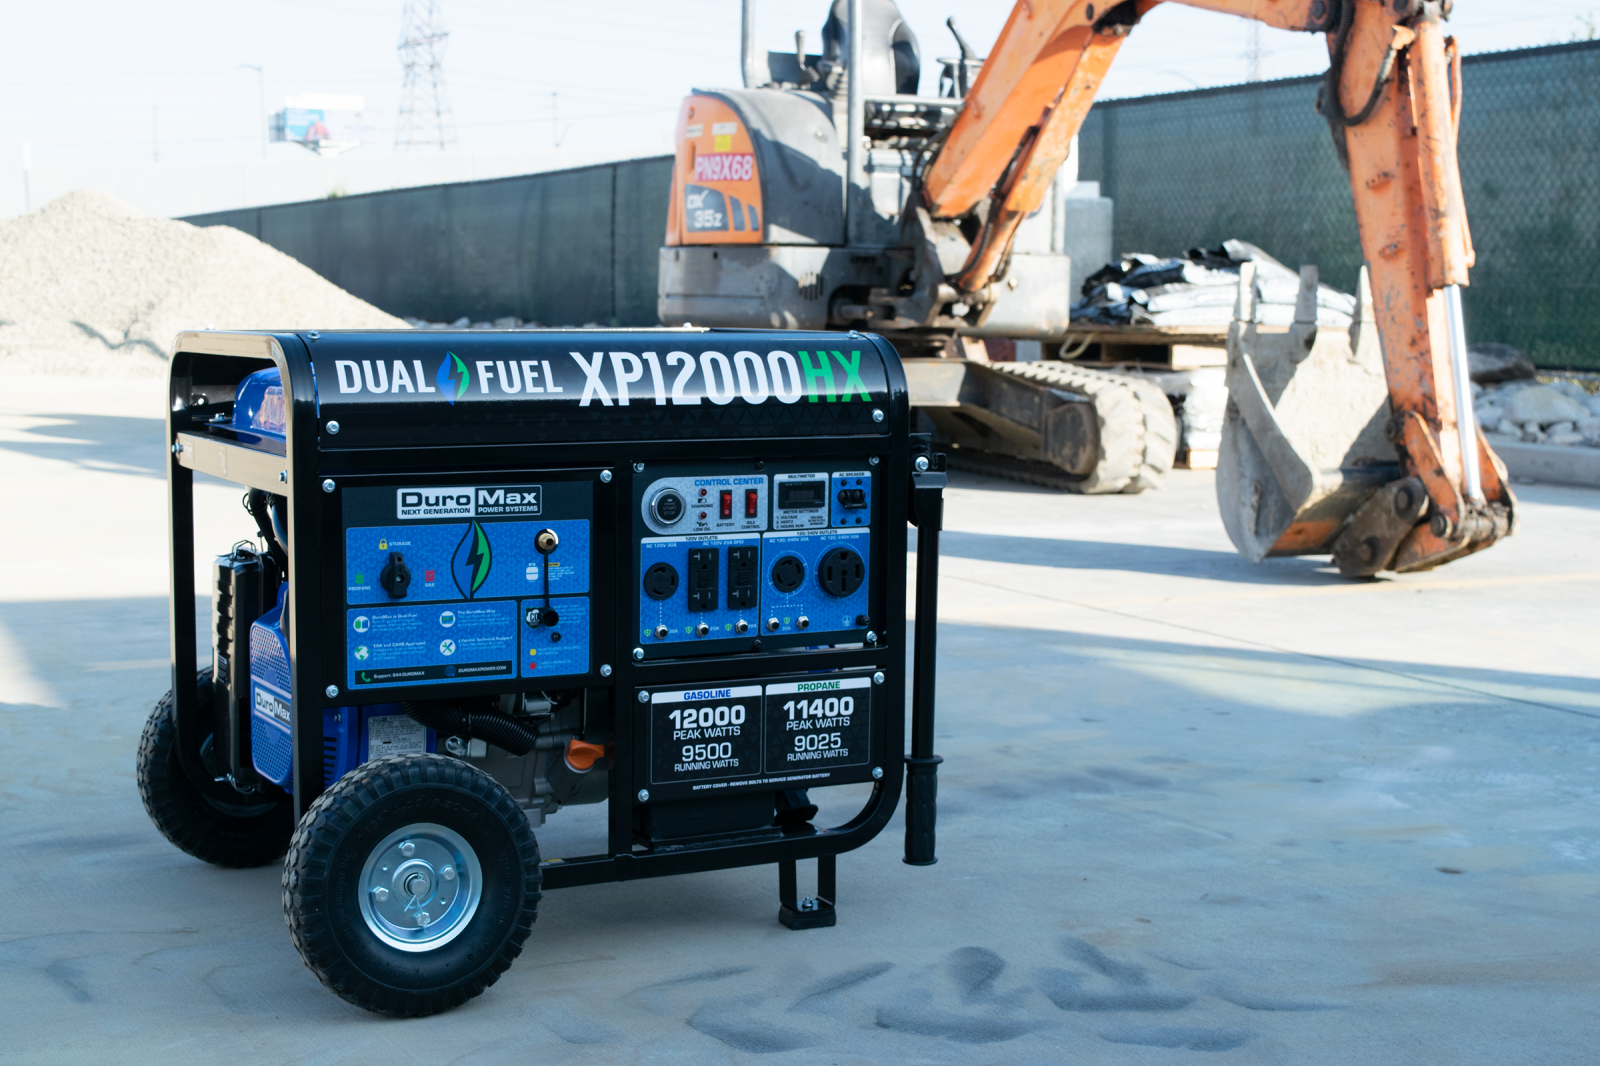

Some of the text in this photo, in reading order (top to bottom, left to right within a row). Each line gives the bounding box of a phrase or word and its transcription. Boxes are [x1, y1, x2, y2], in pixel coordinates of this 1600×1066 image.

[696, 155, 754, 181] PN9X68
[334, 350, 873, 407] DUAL FUEL XP12000HX
[694, 477, 764, 487] CONTROL CENTER
[423, 507, 471, 515] GENERATION
[458, 665, 507, 673] DUROMAXPOWER.COM
[797, 681, 841, 692] PROPANE
[684, 689, 731, 701] GASOLINE
[783, 696, 854, 720] 11400
[668, 705, 746, 730] 12000
[786, 717, 850, 731] PEAK WATTS
[673, 726, 741, 741] PEAK WATTS
[794, 732, 841, 752] 9025
[682, 742, 732, 762] 9500
[787, 748, 848, 762] RUNNING WATTS
[674, 758, 739, 772] RUNNING WATTS
[769, 777, 786, 785] SERVICE
[786, 775, 812, 783] GENERATOR
